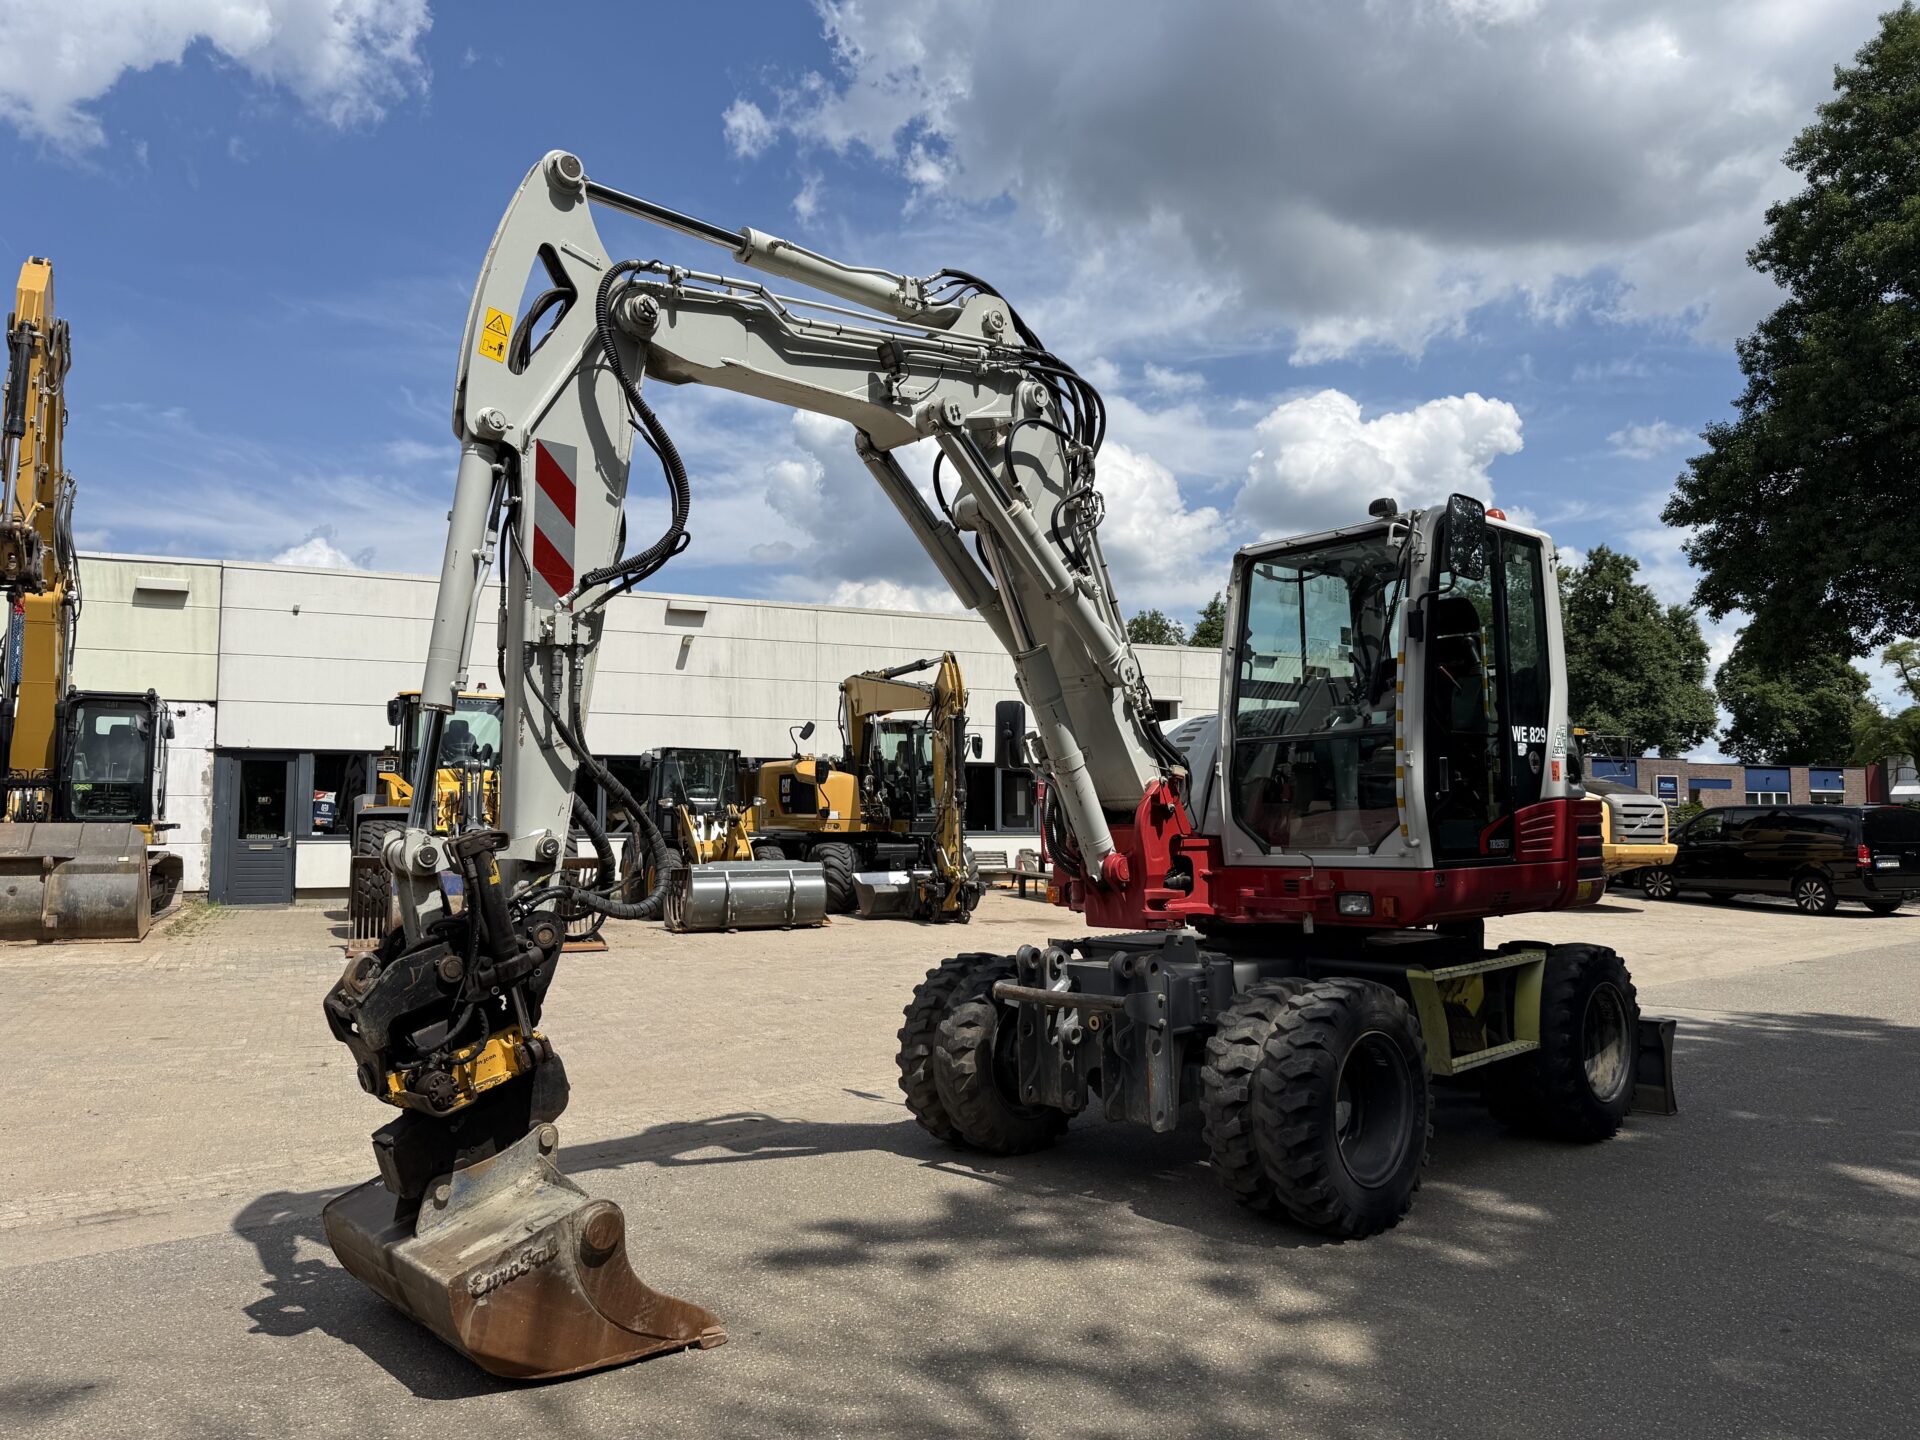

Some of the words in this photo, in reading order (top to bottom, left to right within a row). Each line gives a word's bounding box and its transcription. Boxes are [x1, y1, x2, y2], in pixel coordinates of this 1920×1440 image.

[1511, 725, 1528, 743] WE
[1529, 726, 1546, 744] 829
[257, 796, 269, 804] CAT
